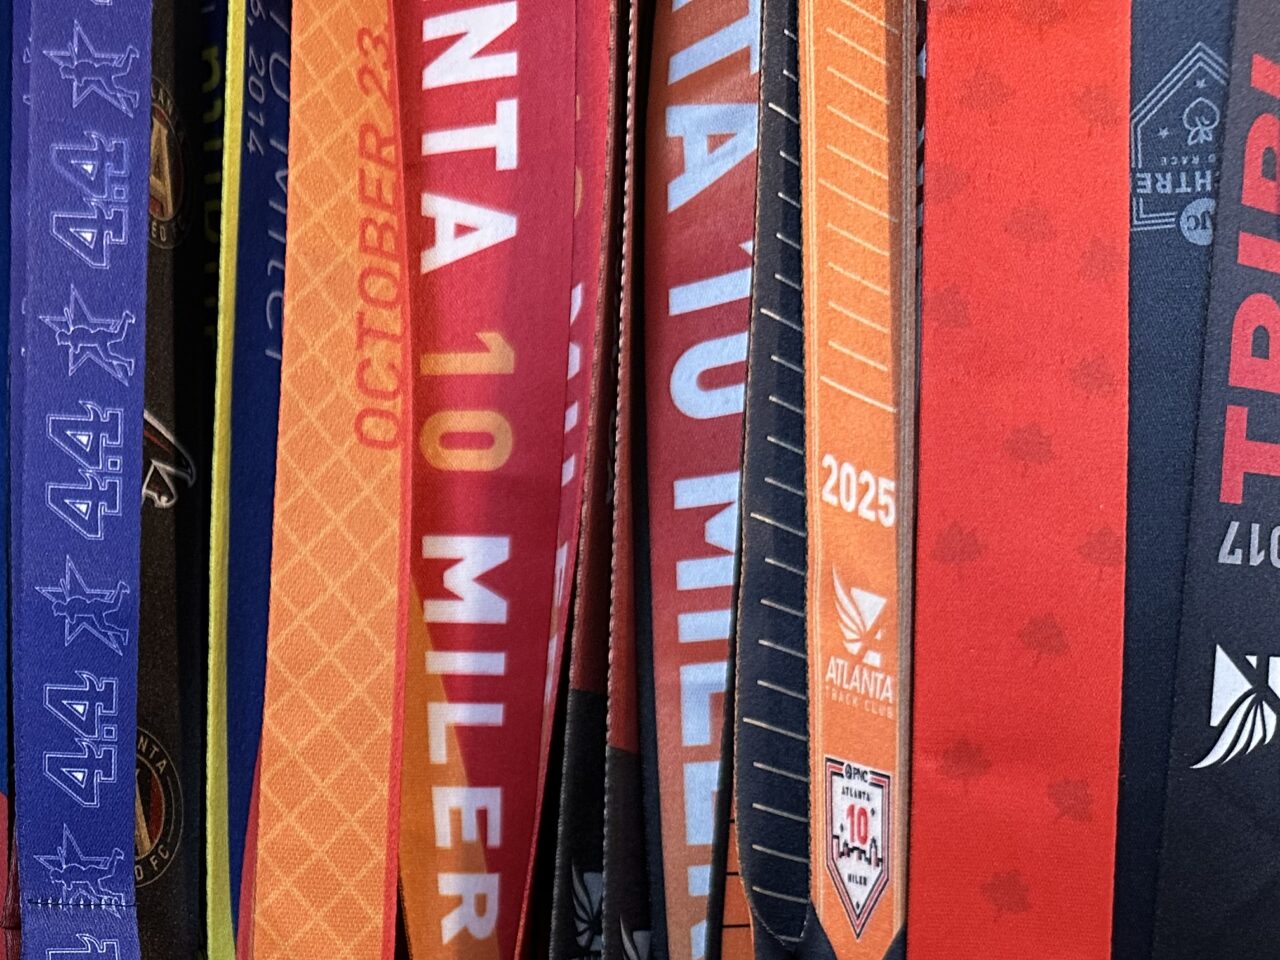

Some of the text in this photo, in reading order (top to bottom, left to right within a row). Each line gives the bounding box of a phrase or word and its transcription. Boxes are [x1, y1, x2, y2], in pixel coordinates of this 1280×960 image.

[248, 46, 266, 156] 2014
[1135, 171, 1219, 193] HTRE
[354, 122, 402, 450] OCTOBER
[420, 331, 515, 471] 10
[821, 453, 896, 528] 2025
[825, 655, 894, 704] ATLANTA
[422, 533, 511, 945] MILER
[846, 803, 869, 845] 10
